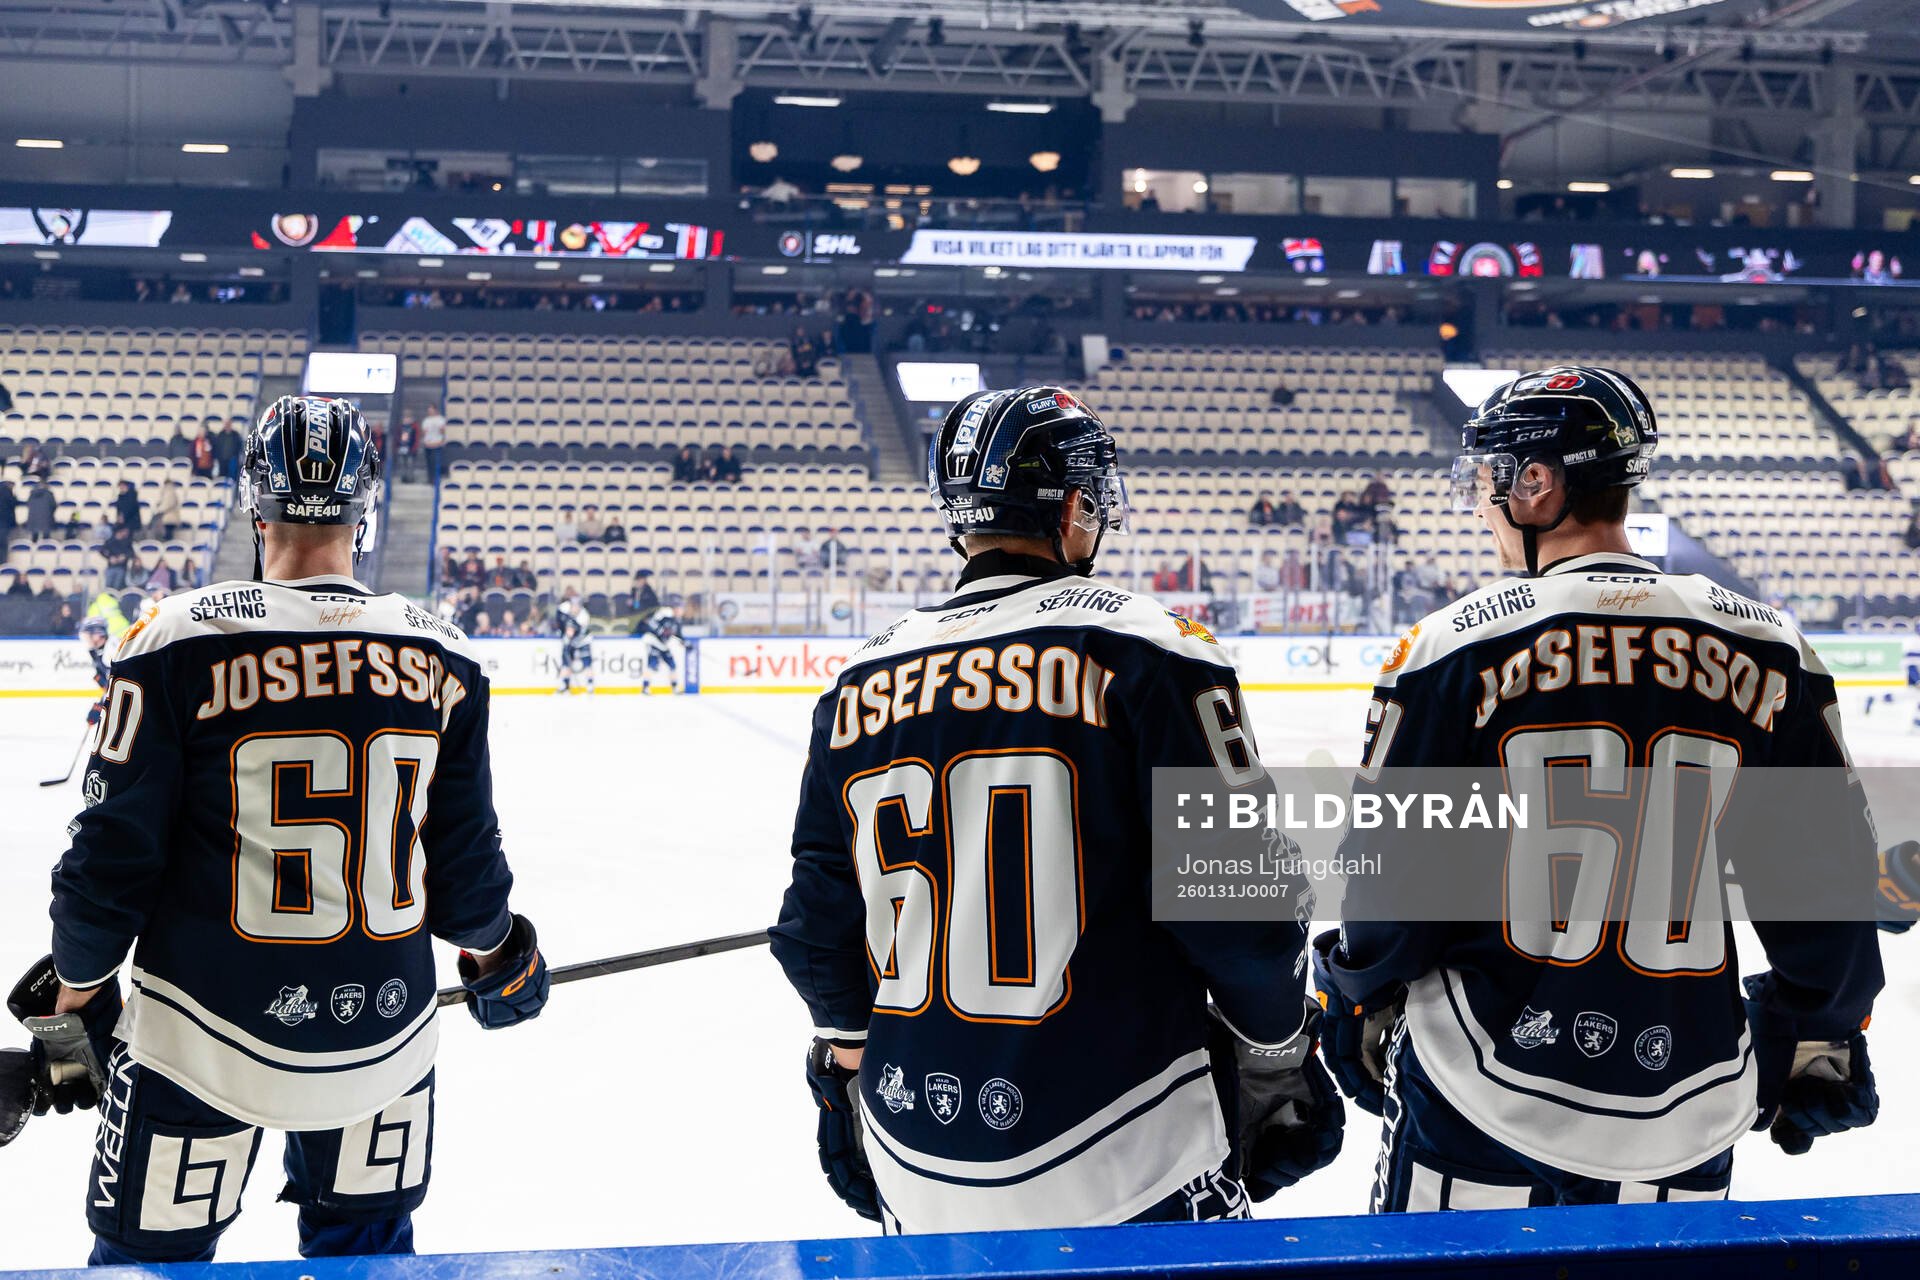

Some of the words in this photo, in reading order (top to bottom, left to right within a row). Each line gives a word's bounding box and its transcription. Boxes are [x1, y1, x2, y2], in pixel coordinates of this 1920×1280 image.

[813, 234, 861, 254] SHL
[932, 239, 963, 254] VISA
[969, 239, 1014, 256] VILKET
[1017, 241, 1041, 257] LAG
[1048, 242, 1076, 258] DITT
[1082, 241, 1131, 259] HJÄRTA
[1137, 244, 1194, 259] KLAPPAR
[1200, 243, 1223, 260] FÖR
[1516, 428, 1560, 443] CCM
[1563, 451, 1587, 464] IMPACT
[311, 462, 323, 480] 11
[1037, 488, 1055, 498] IMPACT
[286, 503, 341, 517] SAFE4U
[945, 506, 995, 524] SAFE4U
[1586, 575, 1657, 585] CCM
[192, 588, 264, 608] ALFING
[310, 595, 366, 605] CCM
[1036, 592, 1125, 614] SEATING
[1050, 586, 1133, 602] ALFING
[1453, 583, 1532, 615] ALFING
[189, 602, 267, 623] SEATING
[937, 603, 999, 623] CCM
[1451, 593, 1537, 633] SEATING
[1707, 595, 1783, 627] SEATING
[229, 727, 441, 945] 60
[1497, 720, 1742, 979] 60
[841, 746, 1086, 1026] 60
[29, 968, 53, 993] CCM
[334, 991, 363, 1000] LAKERS
[32, 1022, 69, 1033] CCM
[1577, 1019, 1614, 1035] LAKERS
[1248, 1046, 1298, 1058] CCM
[928, 1082, 959, 1094] LAKERS
